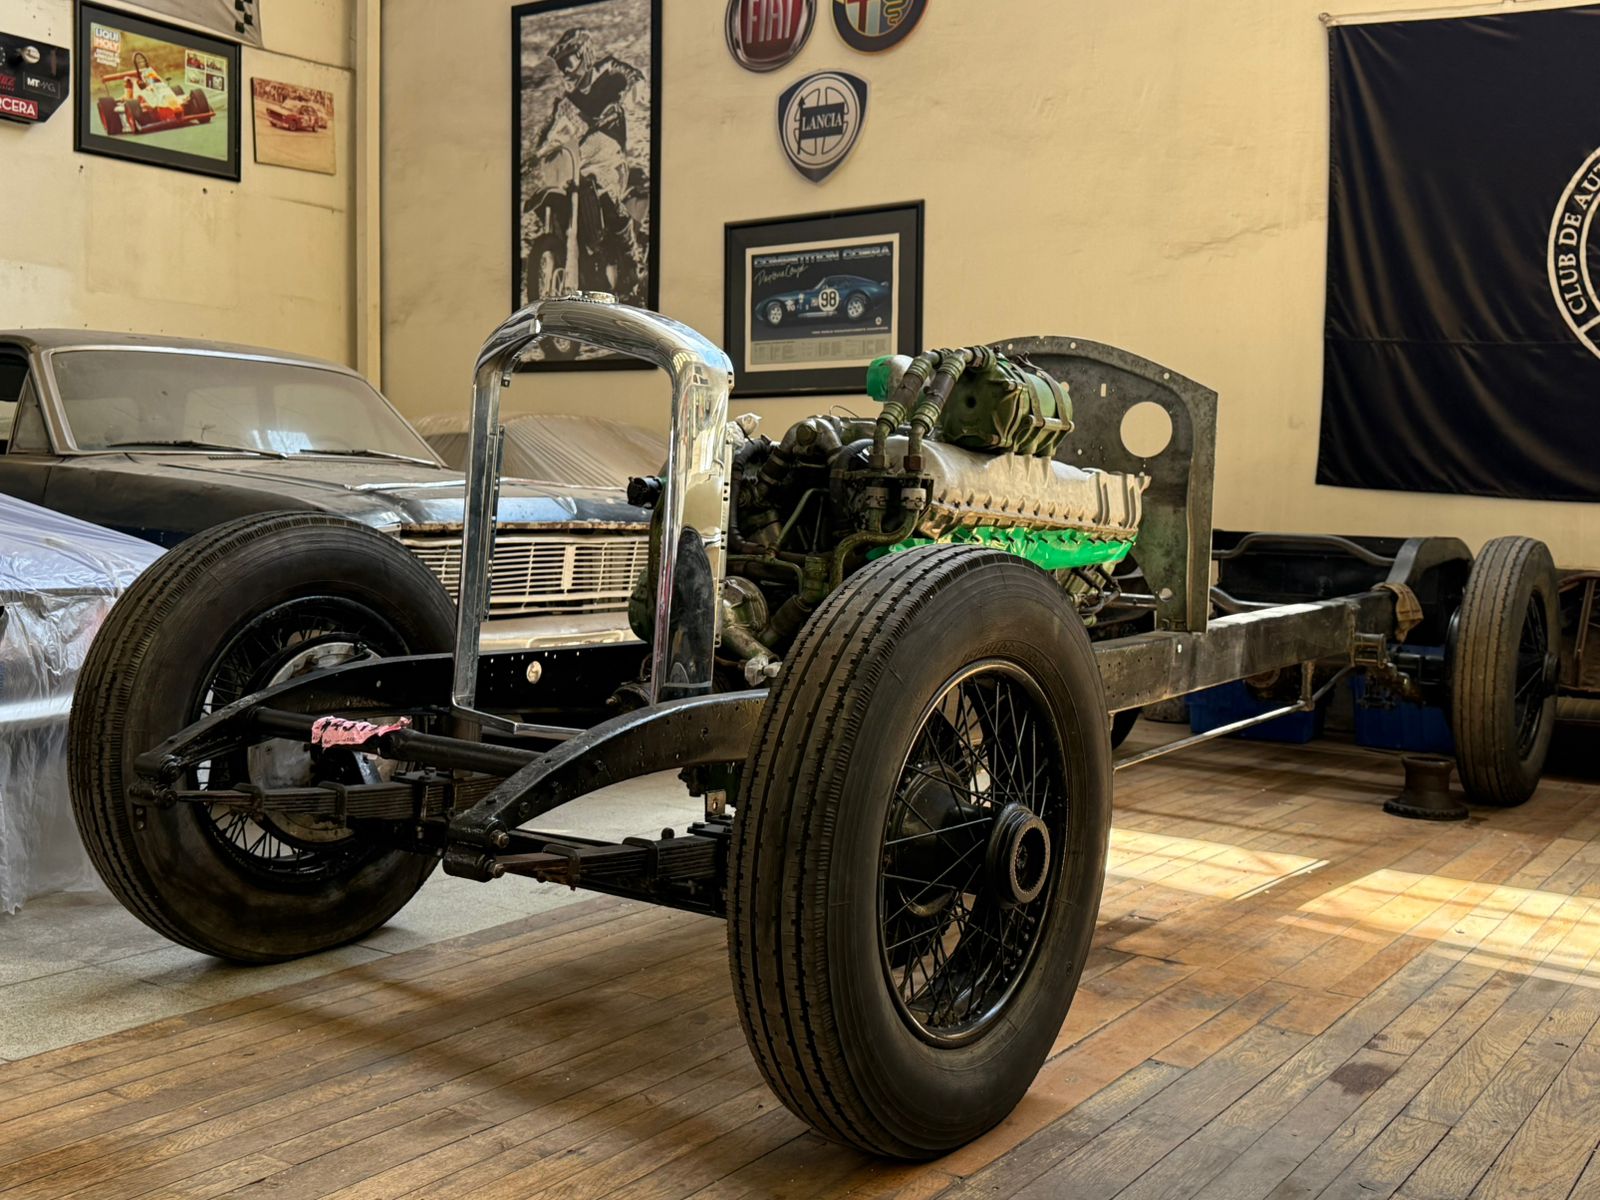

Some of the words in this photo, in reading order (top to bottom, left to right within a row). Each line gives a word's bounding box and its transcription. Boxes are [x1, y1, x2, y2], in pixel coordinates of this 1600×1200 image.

[0, 97, 36, 116] CERA
[801, 112, 842, 131] LANCIA
[1558, 212, 1582, 246] DE
[1558, 252, 1587, 315] CLUB
[821, 291, 837, 308] 98
